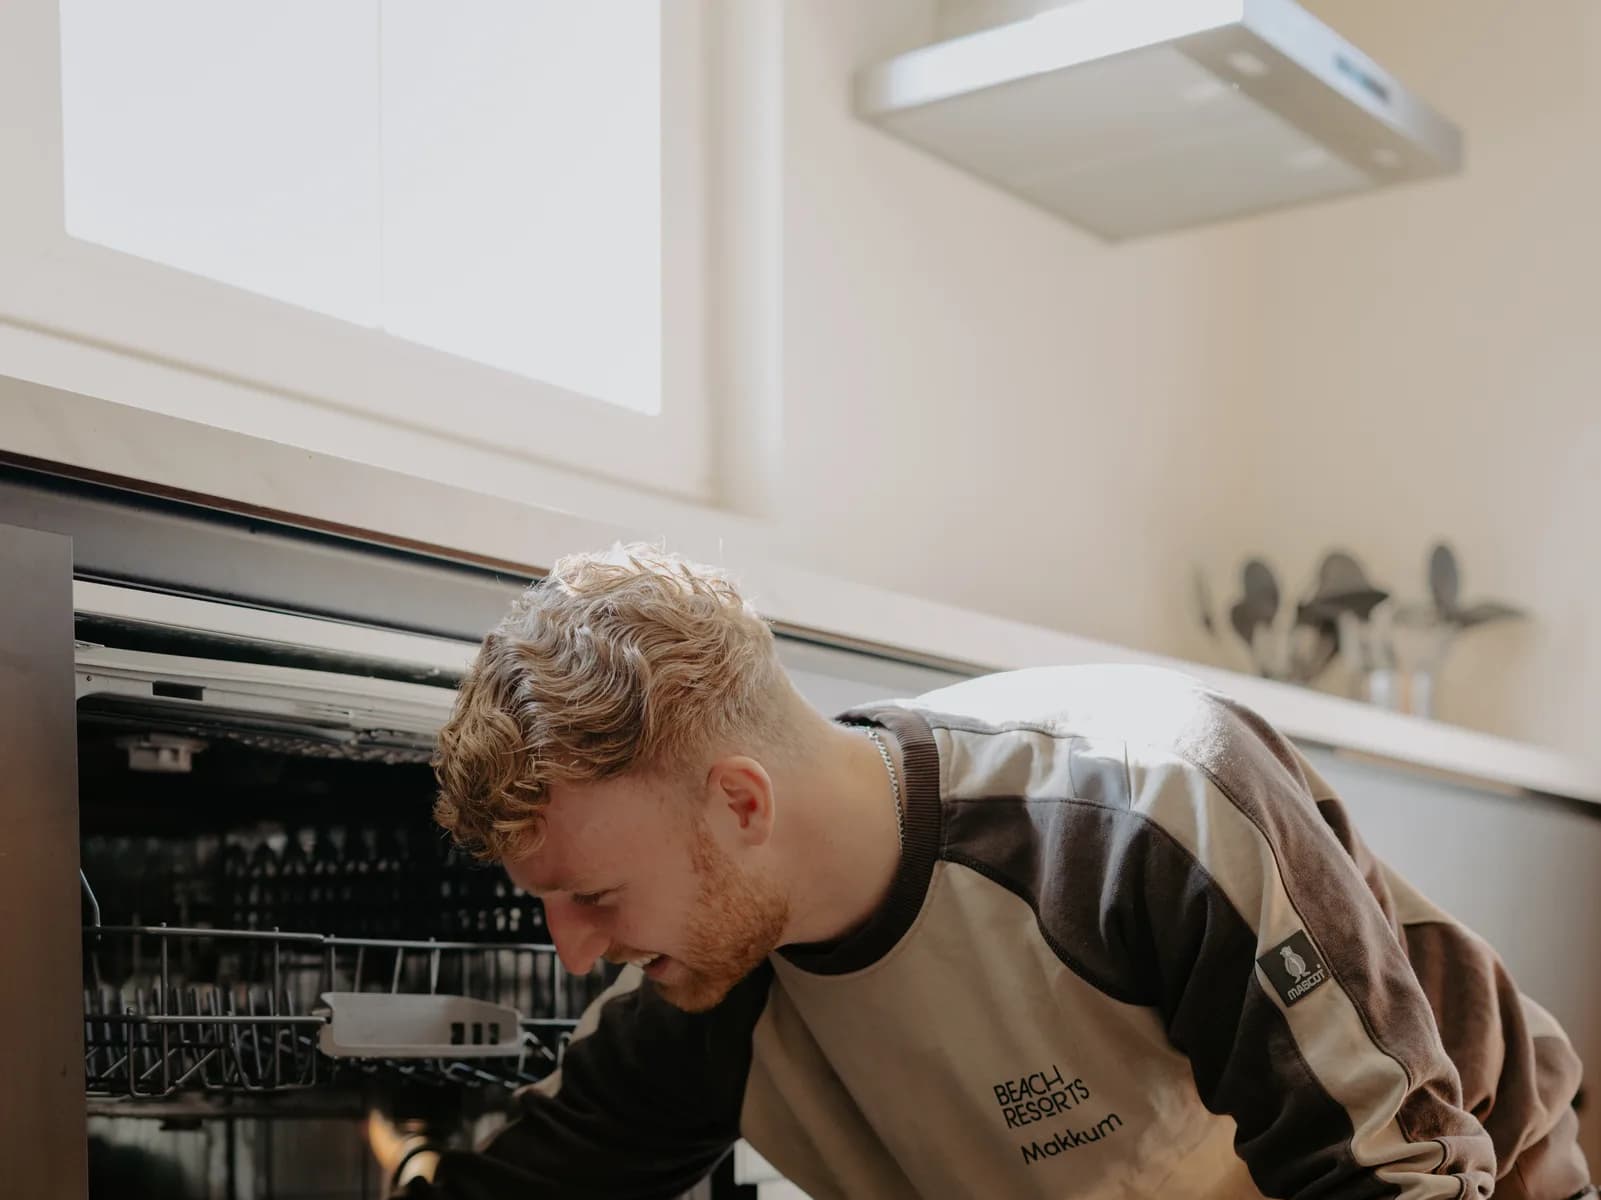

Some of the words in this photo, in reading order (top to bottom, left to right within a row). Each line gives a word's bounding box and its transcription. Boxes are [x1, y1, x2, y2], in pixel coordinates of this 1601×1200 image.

[1287, 968, 1325, 1001] MASCOT
[993, 1064, 1065, 1106] BEACH
[1002, 1078, 1090, 1129] RESORTS
[1020, 1113, 1123, 1166] Makkum
